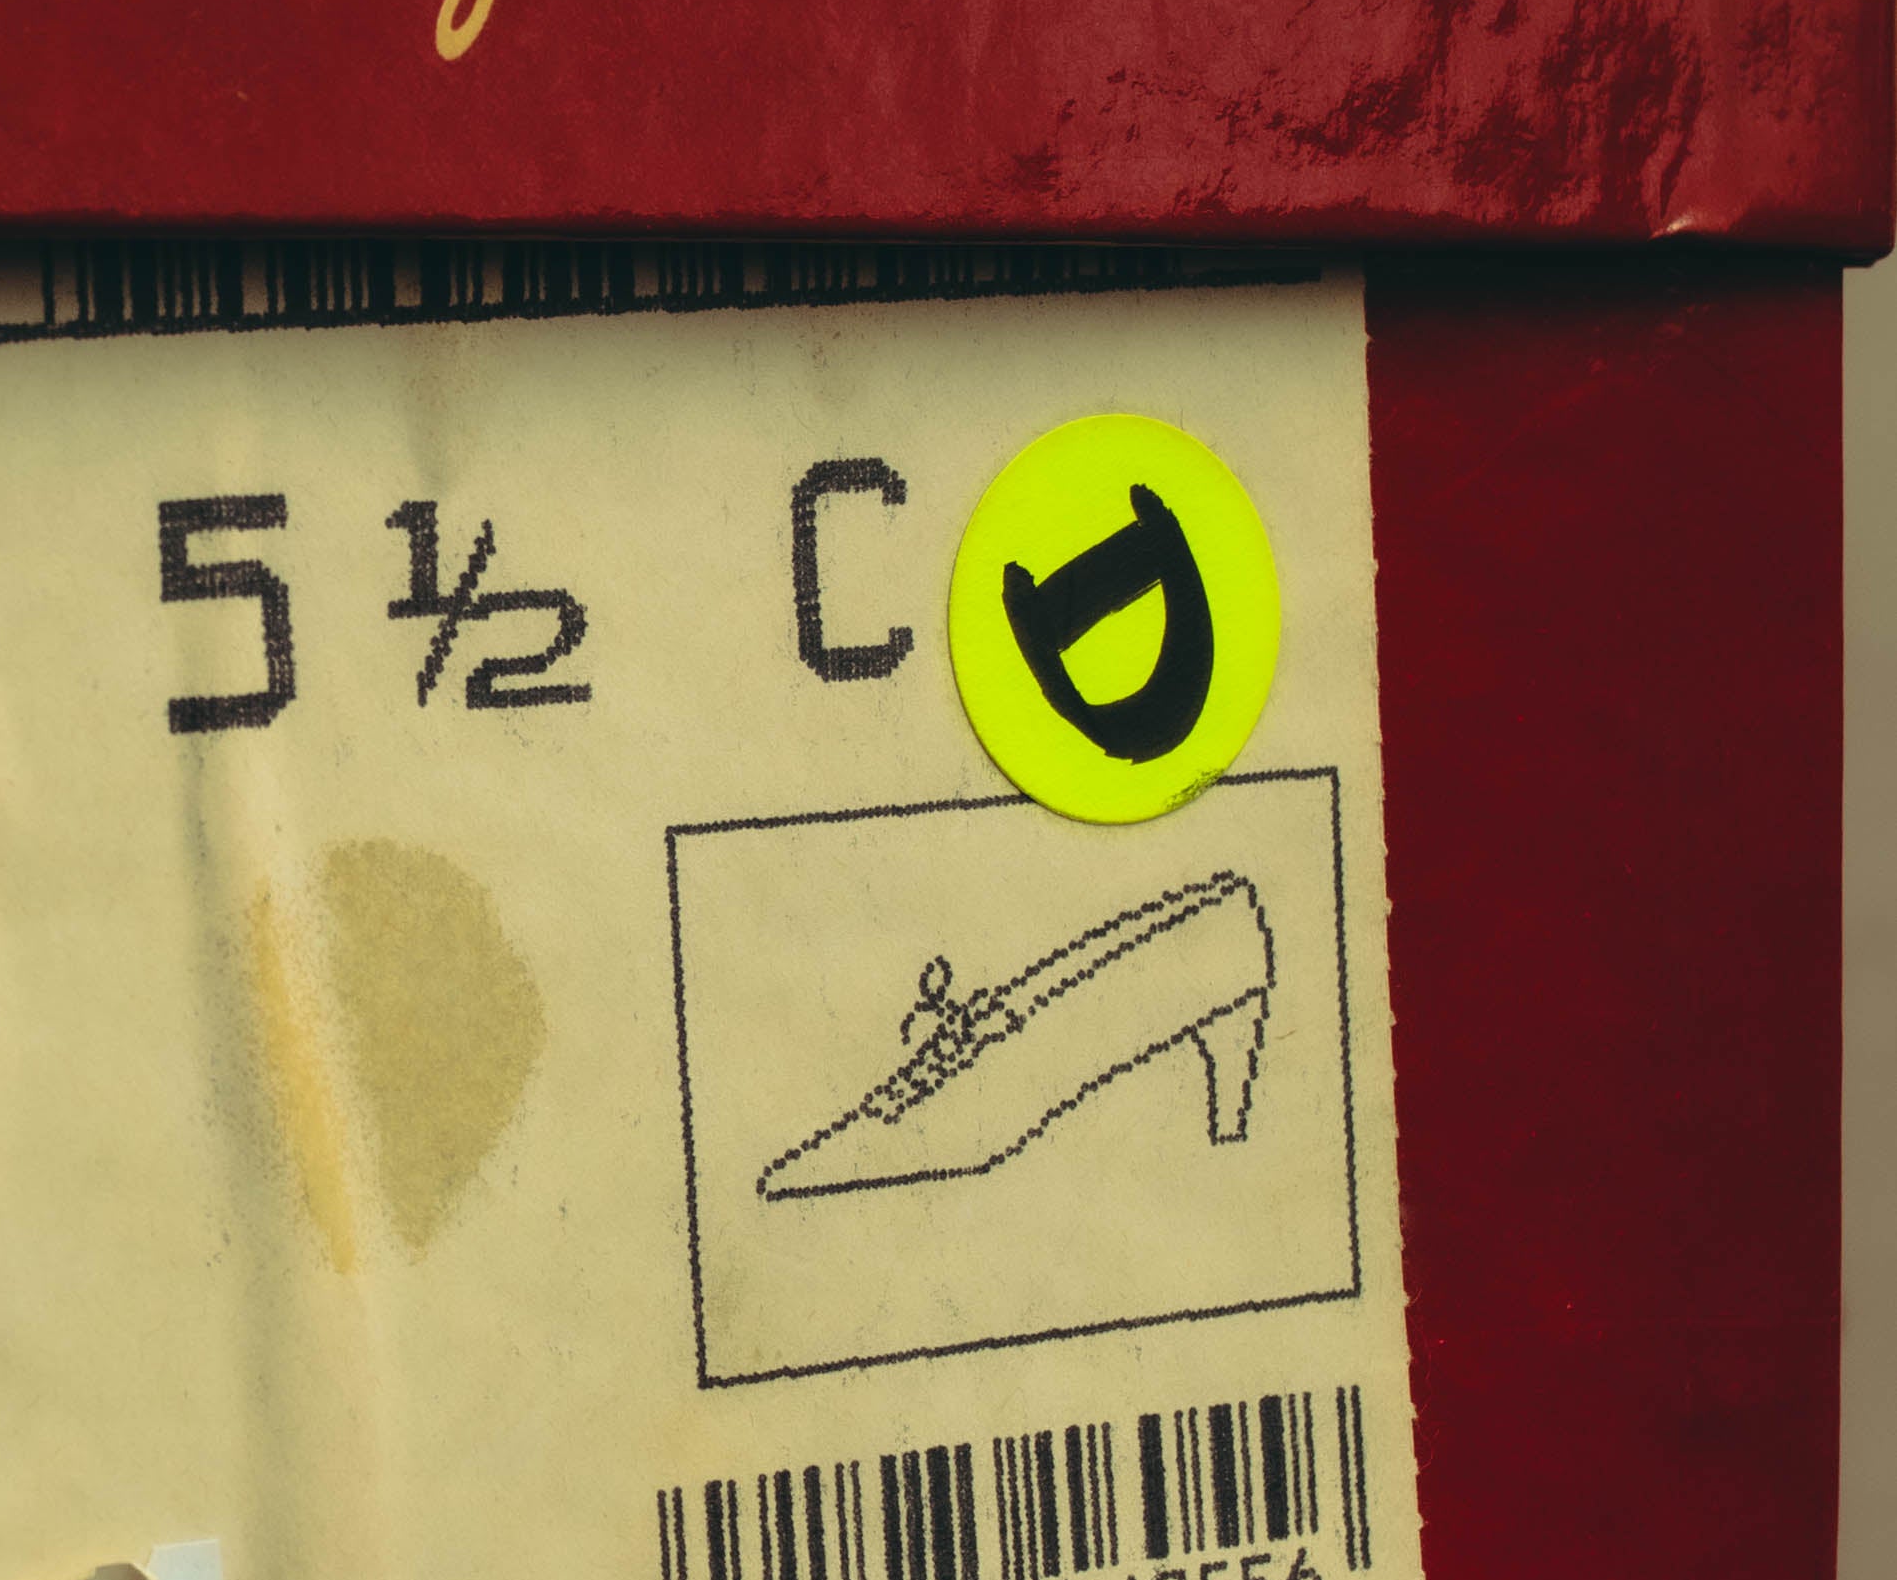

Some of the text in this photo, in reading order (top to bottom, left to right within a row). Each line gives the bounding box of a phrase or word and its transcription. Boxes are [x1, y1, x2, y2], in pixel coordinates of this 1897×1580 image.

[159, 494, 295, 733] 5
[792, 457, 913, 682] C
[1003, 484, 1214, 764] D
